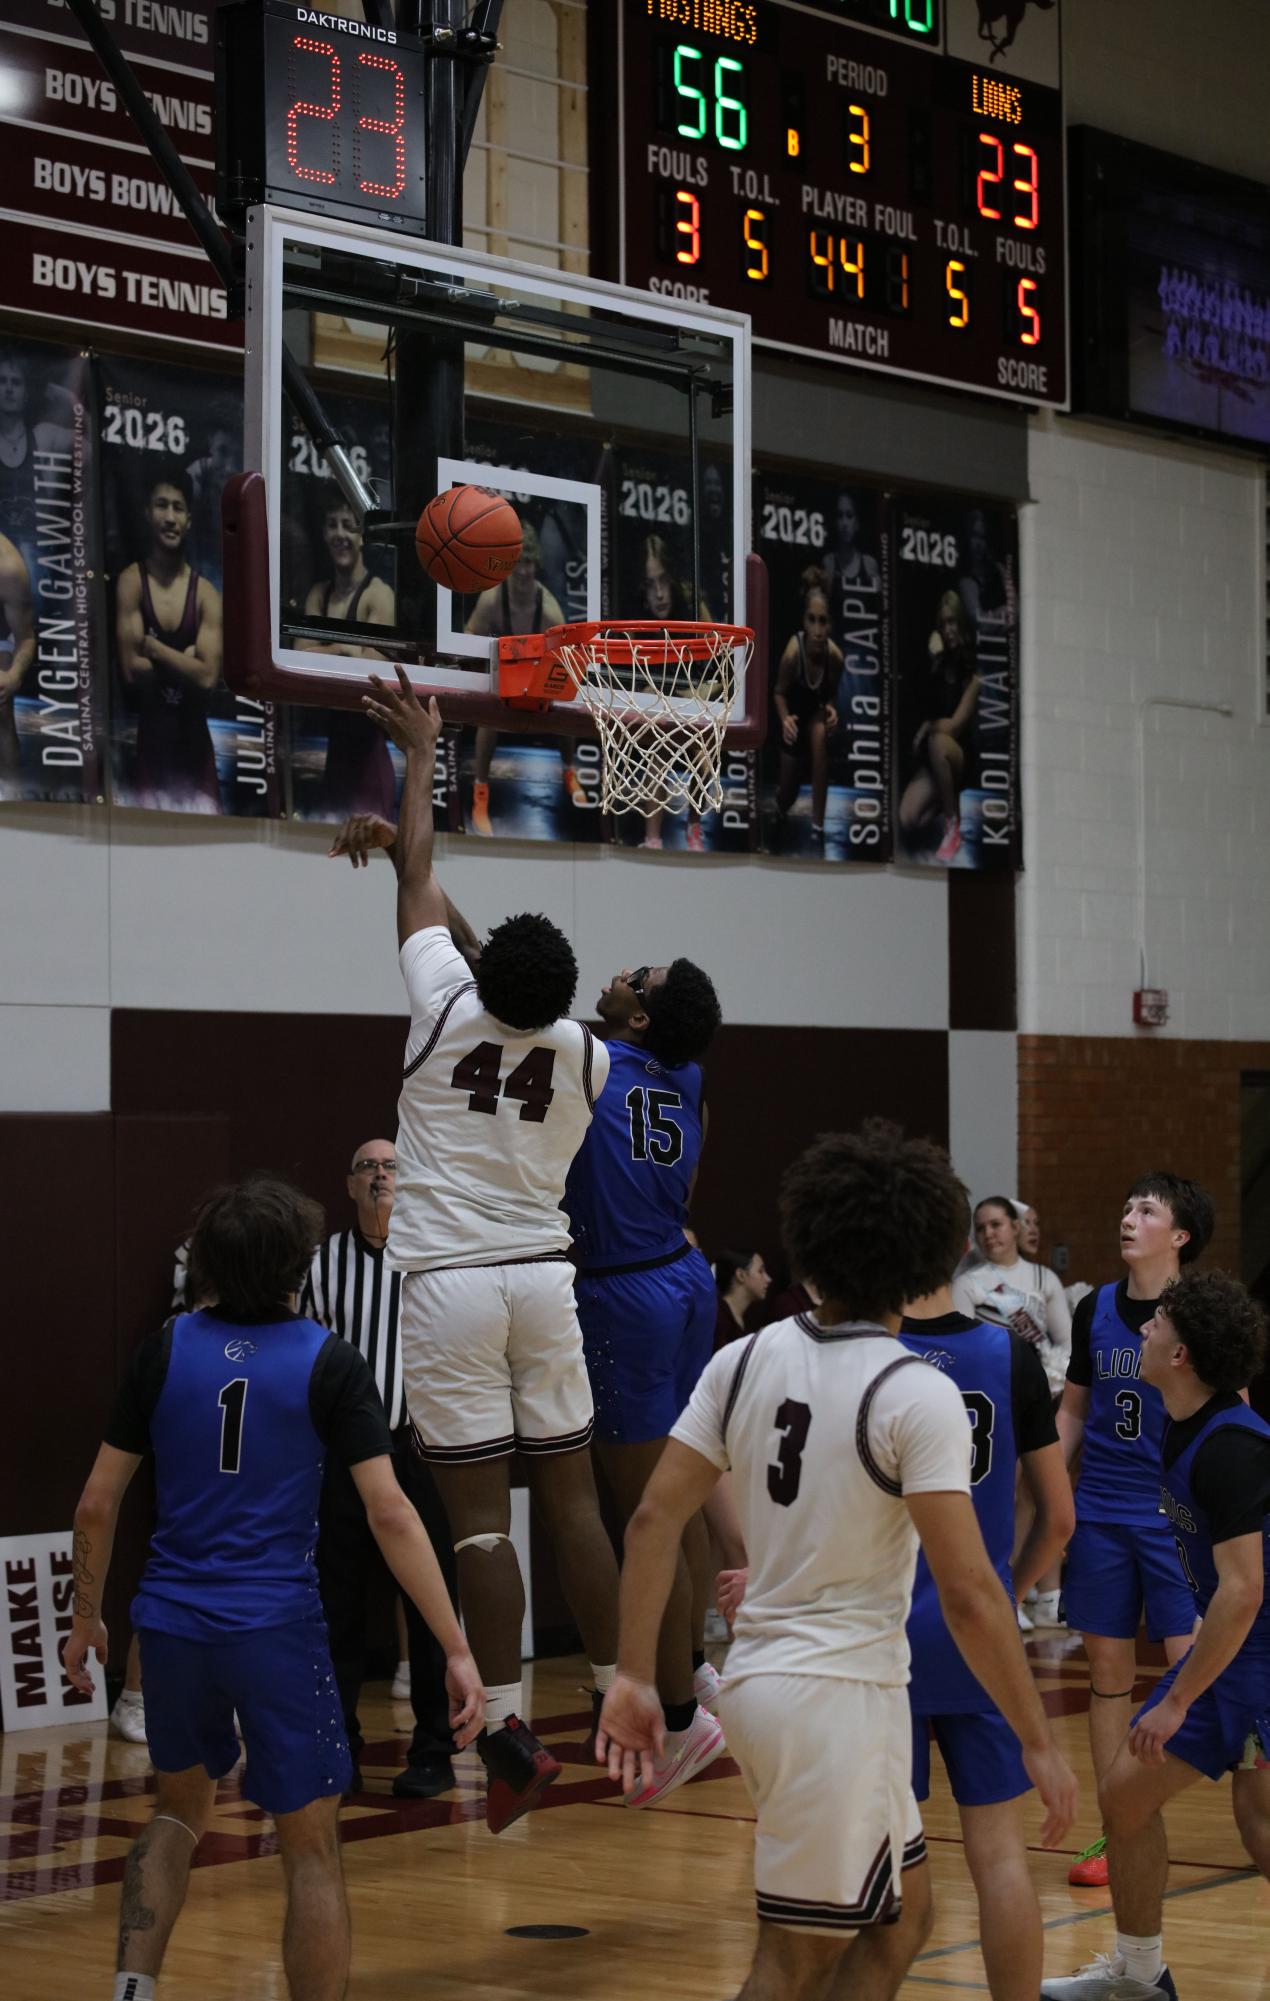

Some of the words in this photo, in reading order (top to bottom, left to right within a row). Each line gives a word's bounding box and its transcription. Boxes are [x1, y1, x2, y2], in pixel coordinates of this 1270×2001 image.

[124, 0, 209, 44] TENNIS
[297, 8, 397, 45] DAKTRONICS
[45, 67, 118, 113] BOYS
[126, 90, 213, 136] NNIS
[673, 44, 747, 150] 56
[826, 54, 888, 98] PERIOD
[287, 36, 405, 198] 23
[849, 104, 869, 174] 3
[33, 156, 107, 203] BOYS
[111, 174, 228, 228] BOWL
[647, 144, 709, 187] FOULS
[729, 165, 781, 206] T.O.L.
[977, 132, 1039, 230] 23
[676, 191, 700, 265] 3
[743, 208, 769, 280] 5
[801, 184, 868, 228] PLAYER
[874, 204, 918, 241] FOUL
[933, 218, 979, 257] T.O.L.
[32, 252, 118, 300] BOYS
[121, 270, 228, 321] TENNIS
[810, 230, 865, 299] 44
[996, 236, 1047, 275] FOULS
[946, 259, 969, 328] 5
[1017, 277, 1041, 345] 5
[828, 317, 890, 358] MATCH
[996, 356, 1049, 393] SCORE
[72, 403, 85, 494] WRESTLING
[102, 405, 188, 455] 2026
[290, 434, 372, 483] 206
[32, 451, 74, 600] GAWITH
[72, 501, 85, 567] SCHOOL
[620, 480, 691, 526] 2026
[762, 504, 827, 548] 2026
[900, 526, 960, 569] 2026
[75, 573, 88, 614] HIGH
[841, 575, 881, 677] CAPE
[77, 620, 91, 689] CENTRAL
[38, 617, 84, 767] DAYGEN
[81, 695, 94, 751] SALINA
[846, 694, 884, 845] Sophia
[979, 752, 1010, 845] KODI
[451, 1041, 557, 1123] 44
[625, 1085, 684, 1168] 15
[1097, 1348, 1142, 1380] LIO
[217, 1377, 249, 1475] 1
[1115, 1389, 1143, 1441] 3
[767, 1397, 812, 1508] 3
[5, 1557, 47, 1708] MAKE
